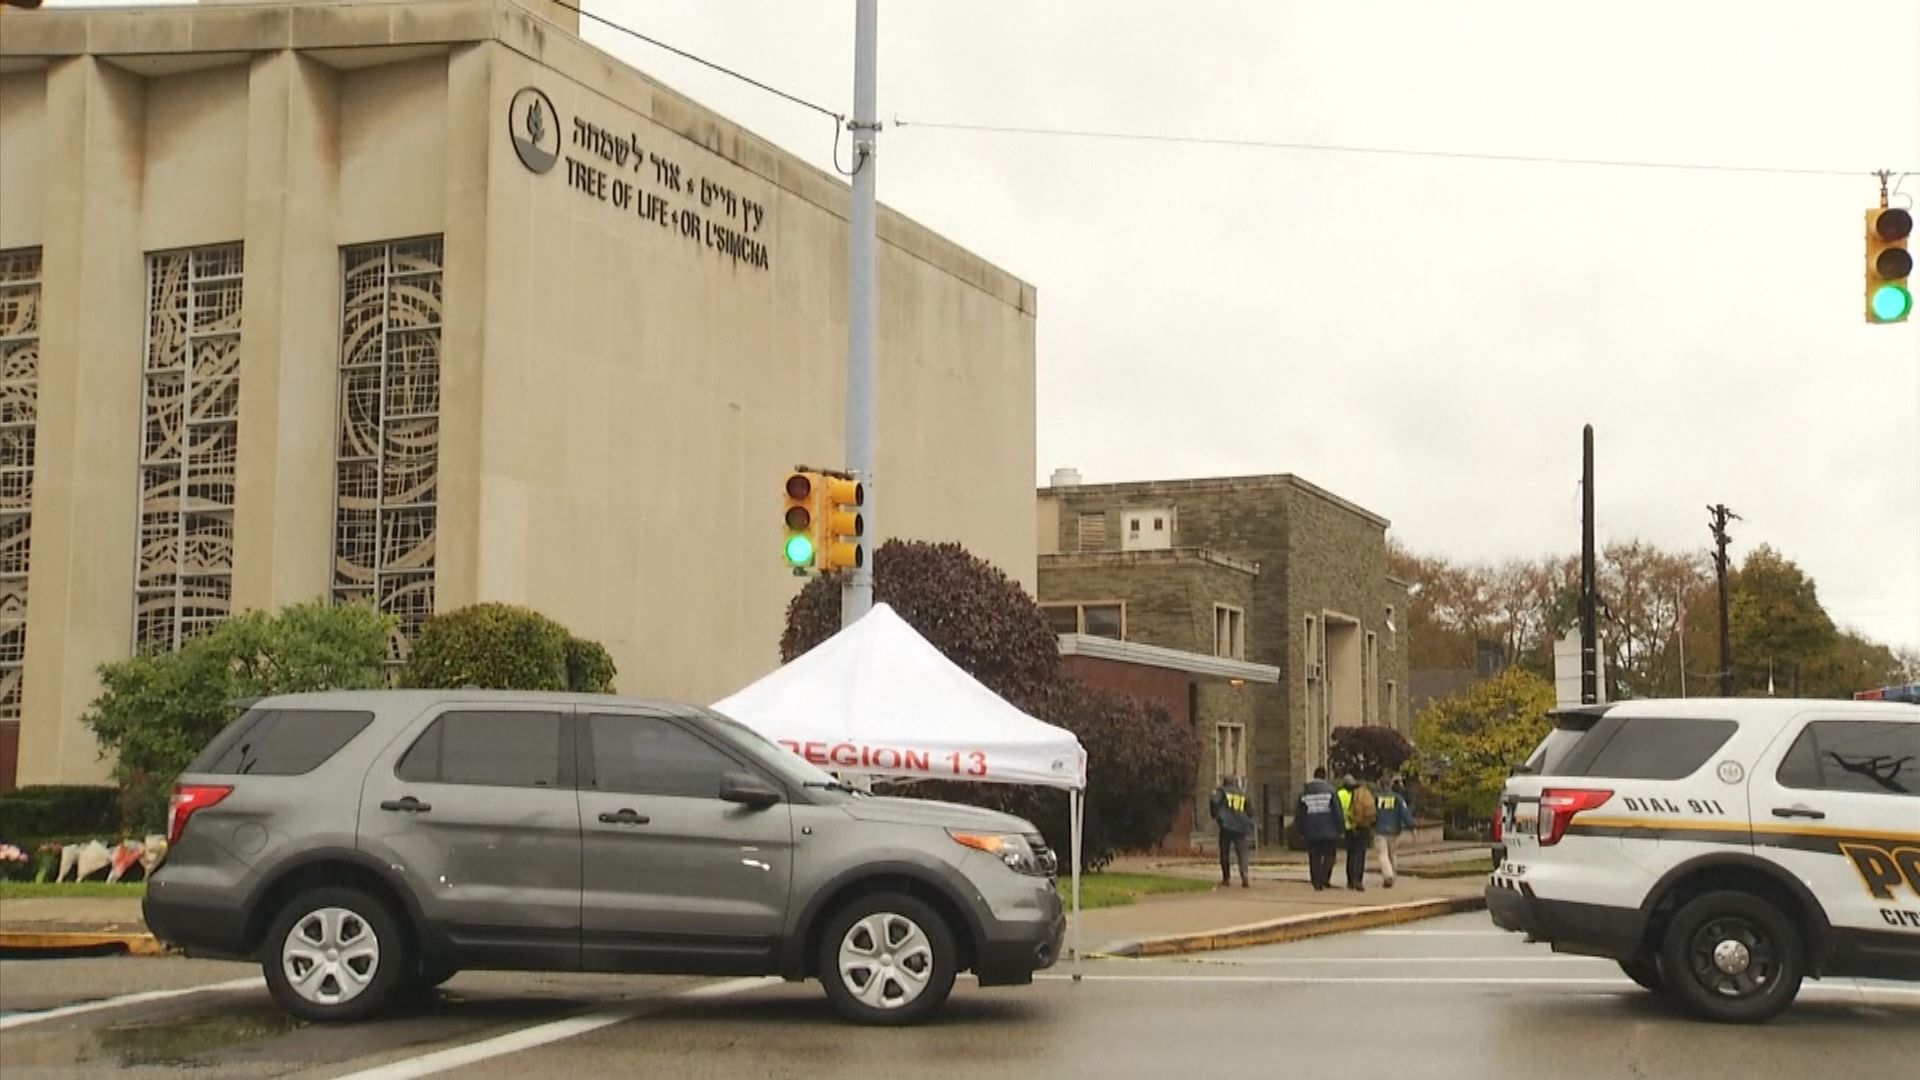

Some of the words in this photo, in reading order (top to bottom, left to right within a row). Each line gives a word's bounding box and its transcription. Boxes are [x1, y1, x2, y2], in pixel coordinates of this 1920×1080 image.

[573, 115, 643, 174] לשמחה
[650, 151, 681, 193] אור
[565, 155, 607, 202] TREE
[612, 178, 633, 211] OF
[637, 187, 669, 228] LIFE
[680, 209, 701, 243] OR
[705, 219, 769, 271] L'SIMCHA
[700, 176, 737, 219] חיים
[742, 195, 763, 234] עץ
[946, 752, 988, 776] 13
[1623, 797, 1680, 813] DIAL
[1687, 799, 1724, 815] 911
